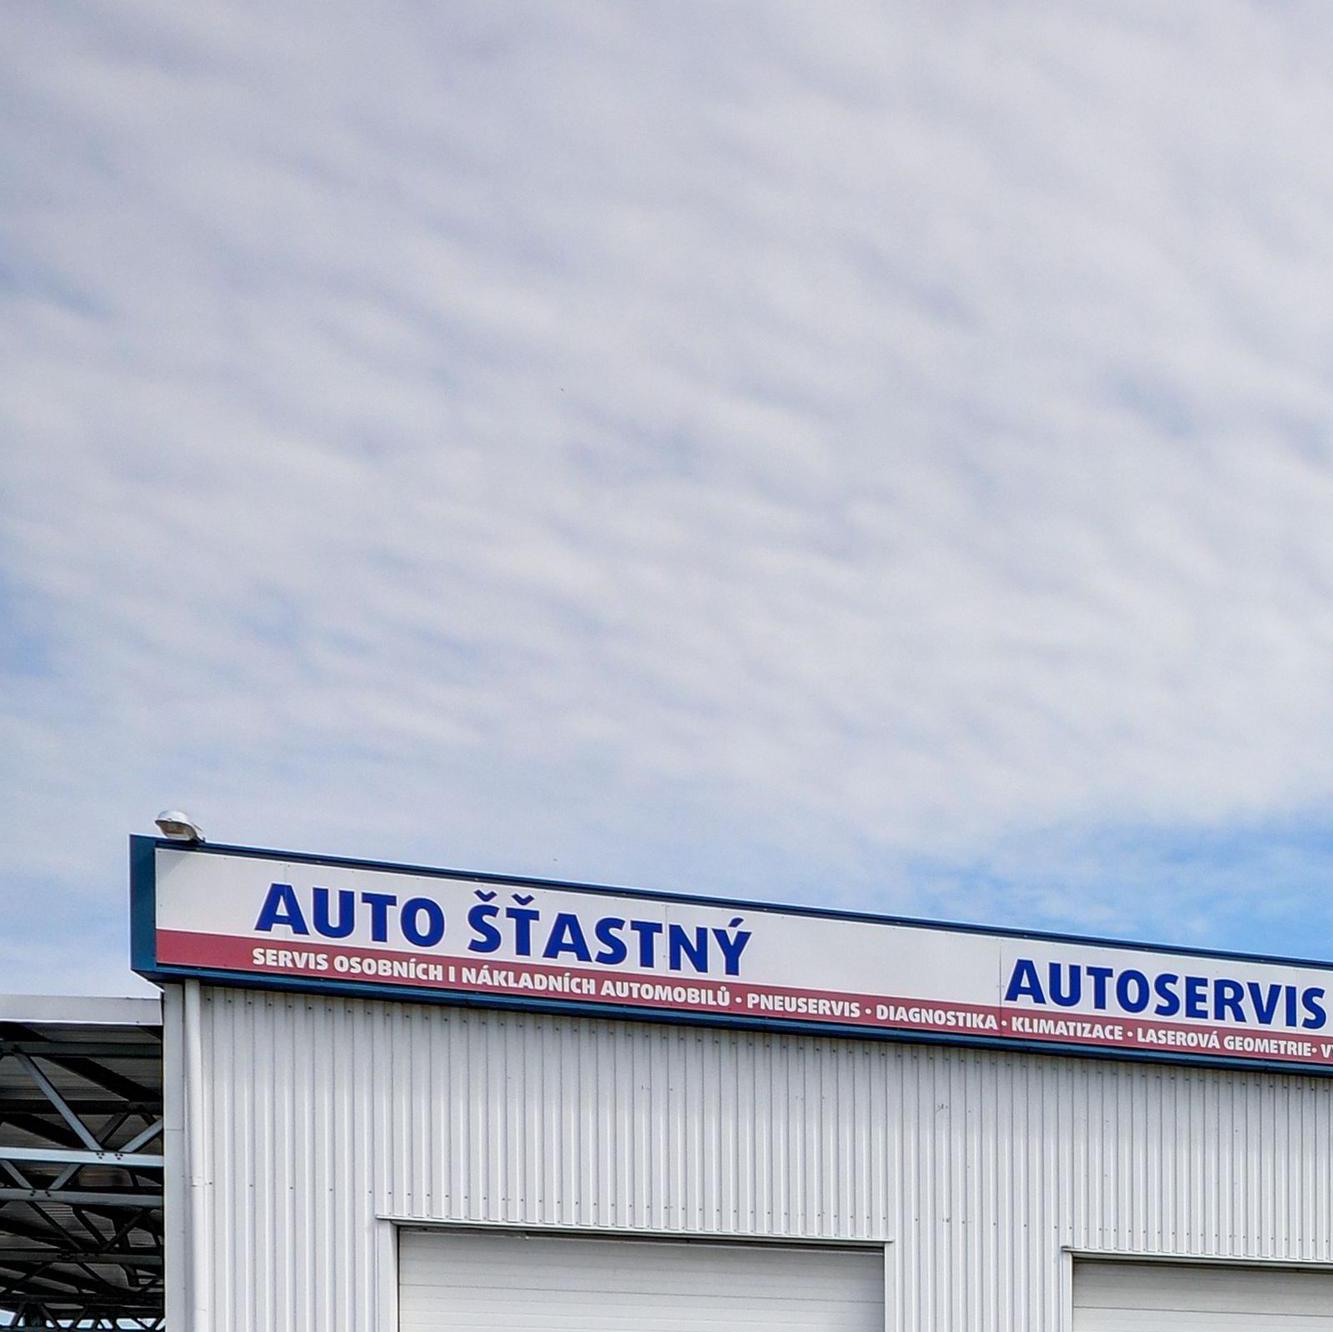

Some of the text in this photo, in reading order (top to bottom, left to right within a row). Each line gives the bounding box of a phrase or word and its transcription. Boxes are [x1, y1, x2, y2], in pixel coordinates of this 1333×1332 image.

[254, 883, 752, 976] AUTO ŠŤASTNÝ
[252, 948, 329, 972] SERVIS
[333, 953, 445, 983] OSOBNÍCH
[448, 965, 456, 984] I
[461, 963, 597, 996] NÁKLADNÍCH
[600, 977, 731, 1007] AUTOMOBILŮ
[747, 992, 861, 1018] PNEUSERVIS
[876, 1004, 998, 1030] DIAGNOSTIKA
[1011, 1016, 1123, 1041] KLIMATIZACE
[1137, 1027, 1220, 1049] LASEROVÁ
[1224, 1035, 1311, 1057] GEOMETRIE
[1004, 959, 1327, 1030] AUTOSERVIS
